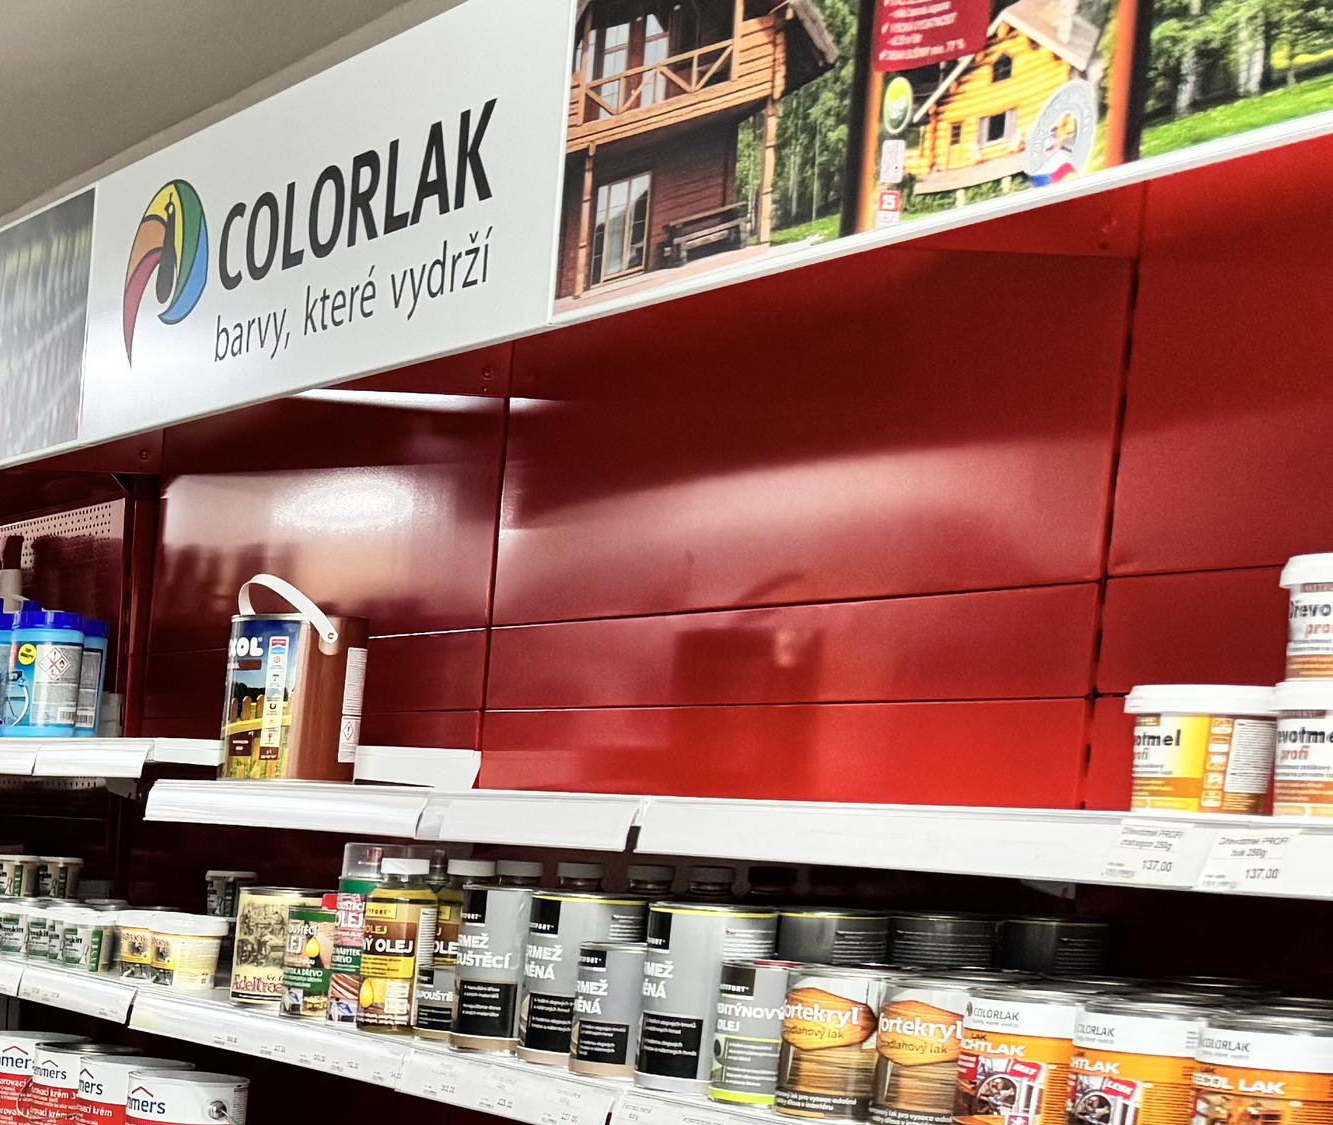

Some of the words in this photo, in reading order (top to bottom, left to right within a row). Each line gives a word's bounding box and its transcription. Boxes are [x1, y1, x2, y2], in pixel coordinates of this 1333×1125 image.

[218, 98, 498, 291] COLORLAK
[214, 307, 291, 362] barvy,
[303, 265, 376, 337] které
[390, 225, 494, 320] vydrží
[1143, 860, 1172, 872] 137,00
[1245, 868, 1279, 880] 137,00
[375, 938, 413, 953] OLEJ
[973, 1007, 1019, 1021] COLORLAK
[829, 1027, 844, 1040] lak
[930, 1042, 947, 1054] lak
[1238, 1079, 1285, 1096] LAK
